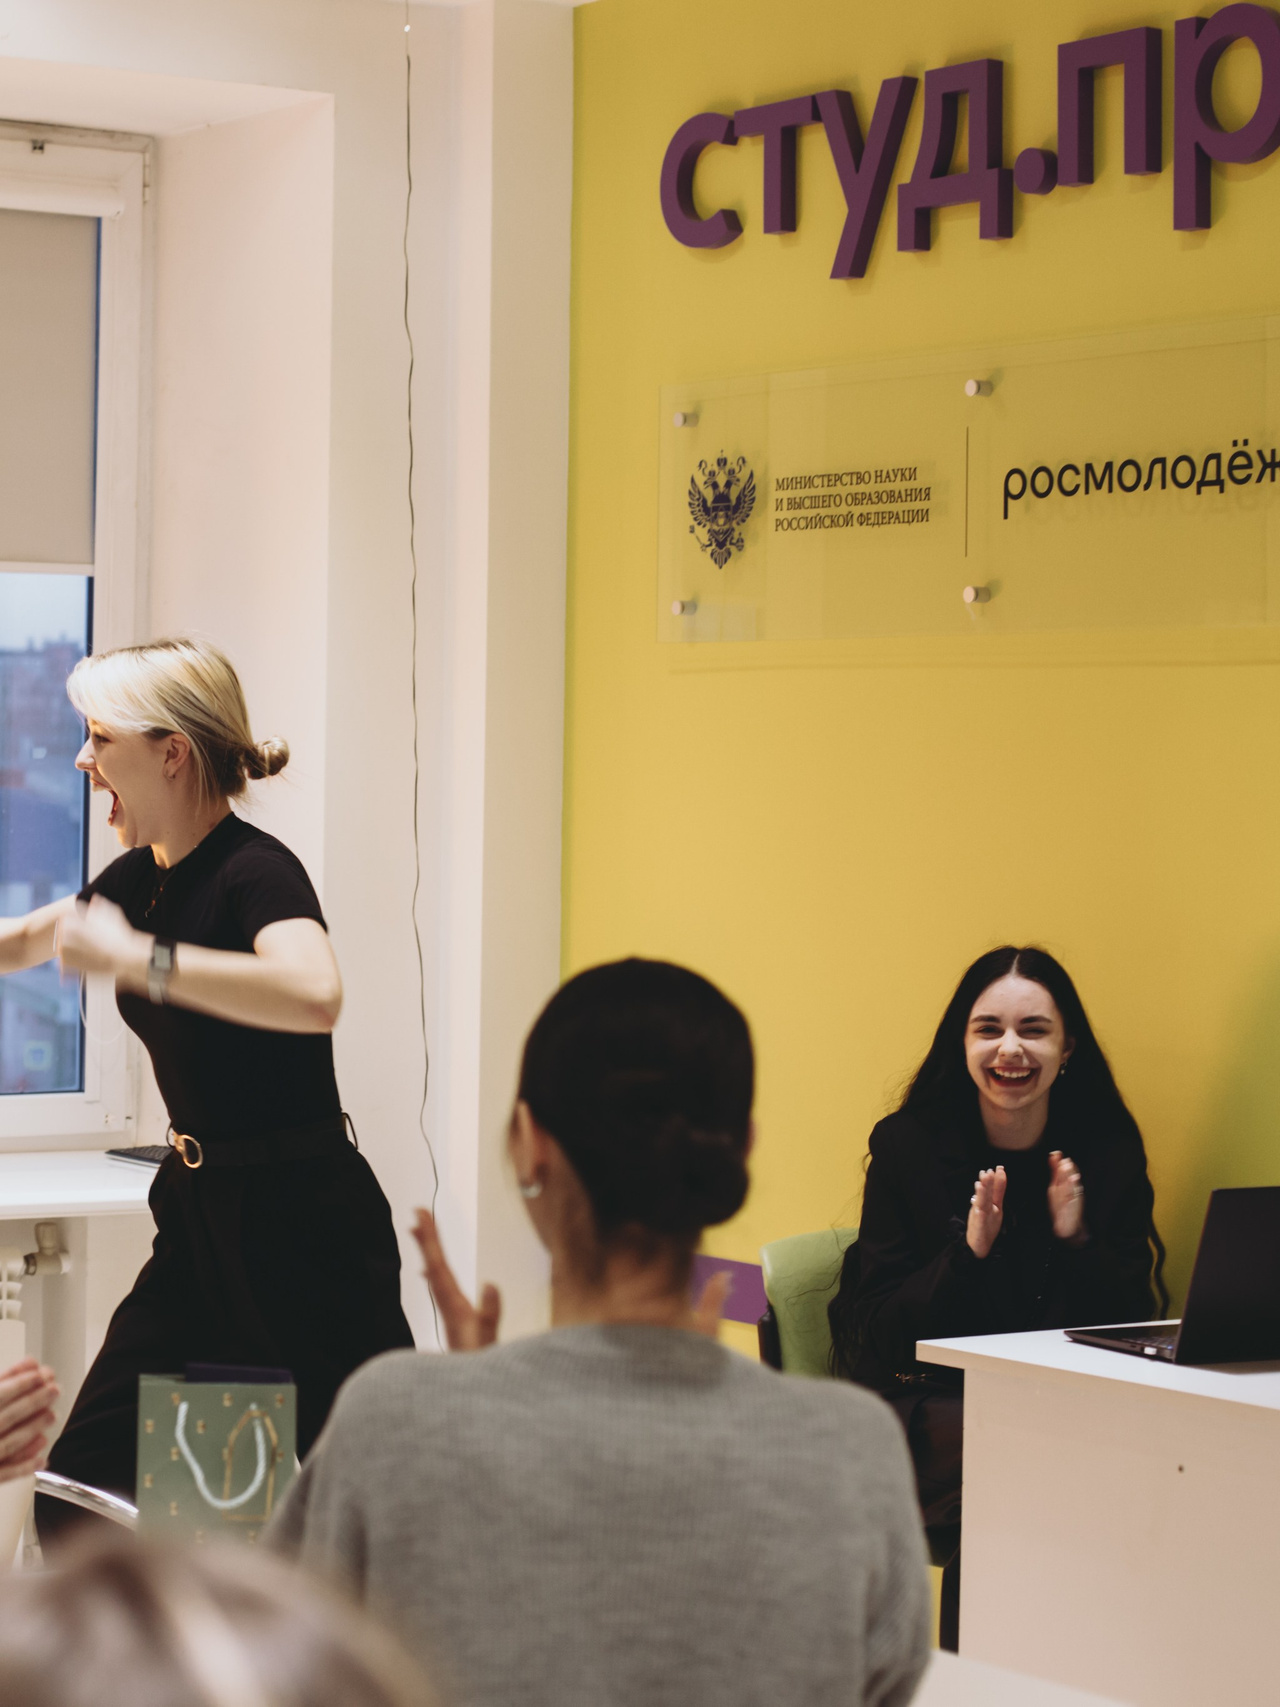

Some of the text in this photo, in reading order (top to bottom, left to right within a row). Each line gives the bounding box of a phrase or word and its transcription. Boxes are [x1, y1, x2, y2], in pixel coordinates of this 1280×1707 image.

[775, 467, 917, 492] МИНИСТЕРСТВО НАУКИ
[775, 486, 931, 512] И ВЫСШЕГО ОБРАЗОВАНИЯ
[775, 508, 930, 532] РОССИЙСКОЙ ФЕДЕРАЦИИ
